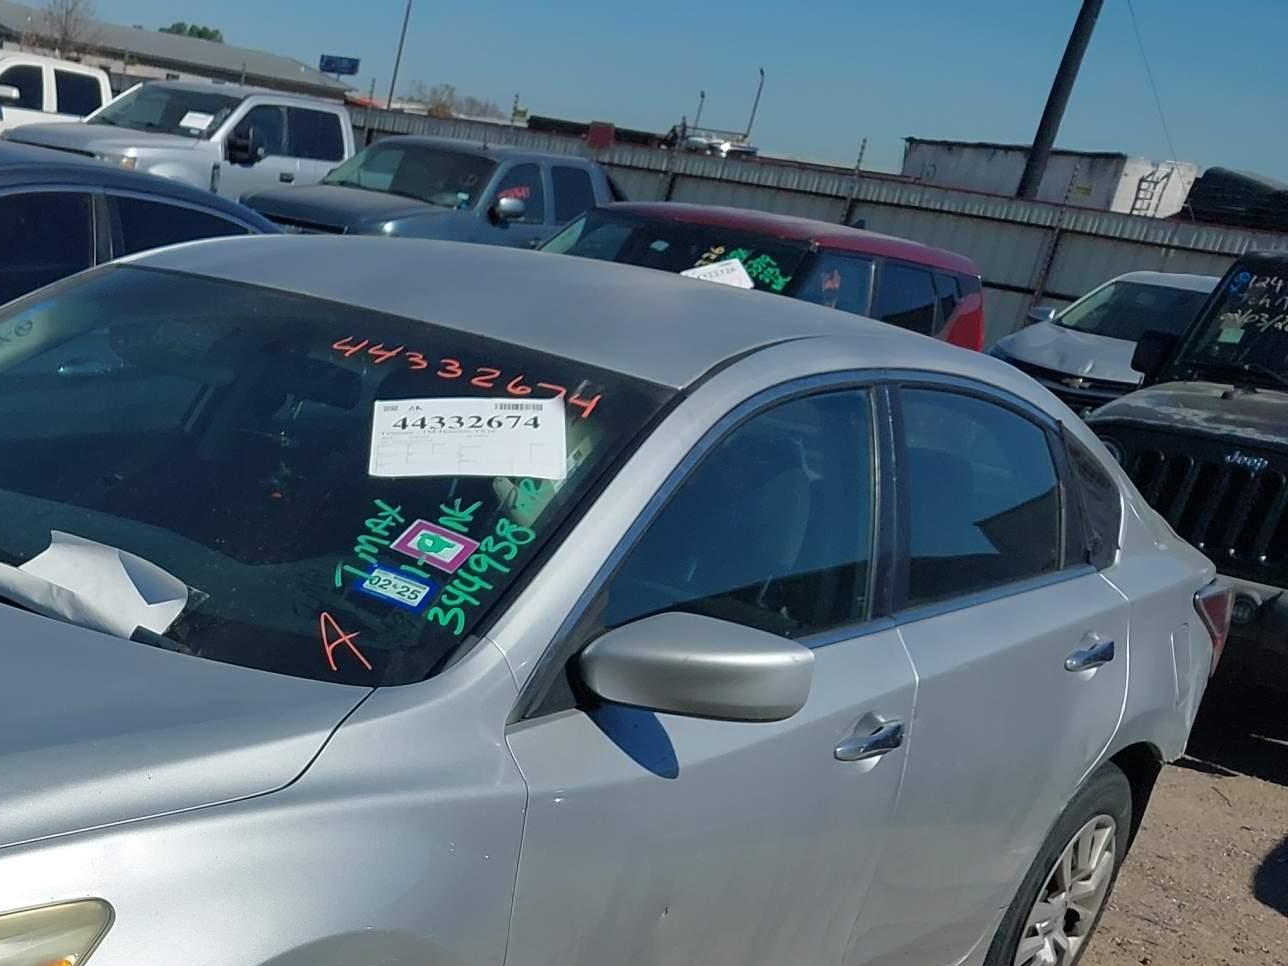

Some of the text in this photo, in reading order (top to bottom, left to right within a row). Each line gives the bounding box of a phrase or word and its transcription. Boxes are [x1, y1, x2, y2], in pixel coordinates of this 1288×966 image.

[332, 336, 601, 418] 44332674
[392, 415, 541, 430] 44332674
[427, 517, 536, 636] 344938
[320, 611, 373, 672] A
